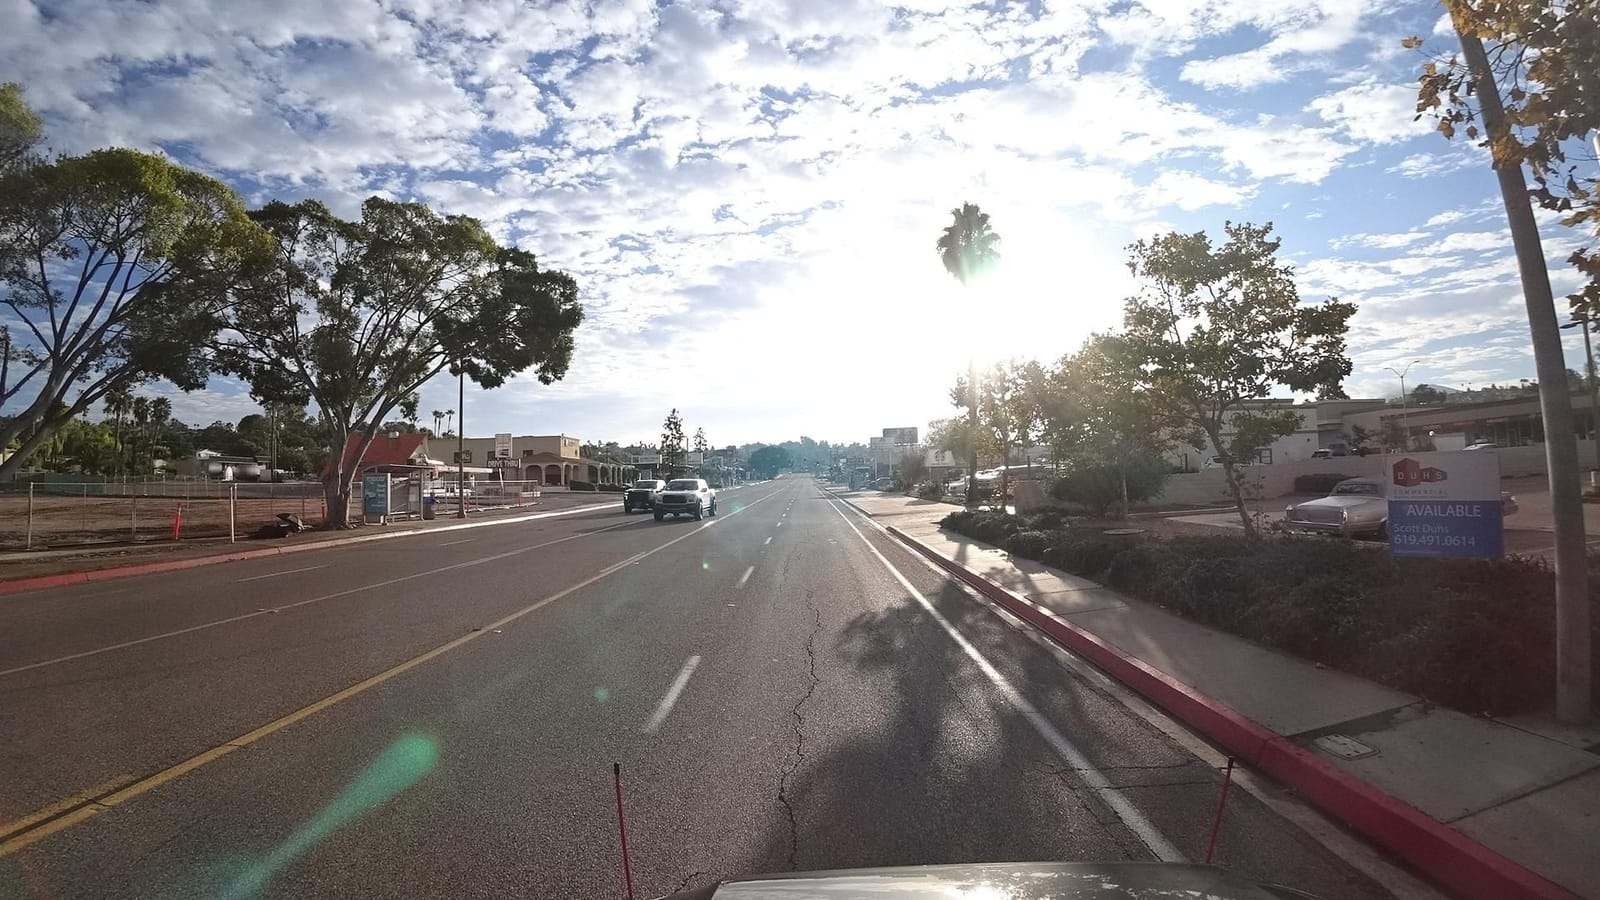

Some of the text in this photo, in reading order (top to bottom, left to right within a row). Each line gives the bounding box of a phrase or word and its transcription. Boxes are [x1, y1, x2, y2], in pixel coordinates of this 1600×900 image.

[488, 460, 518, 468] DRIVE THRU
[1397, 472, 1443, 480] DUHS
[1406, 504, 1481, 517] AVAILABLE
[1393, 523, 1449, 534] Scott Duhs
[1393, 534, 1476, 547] 619.491.0614
